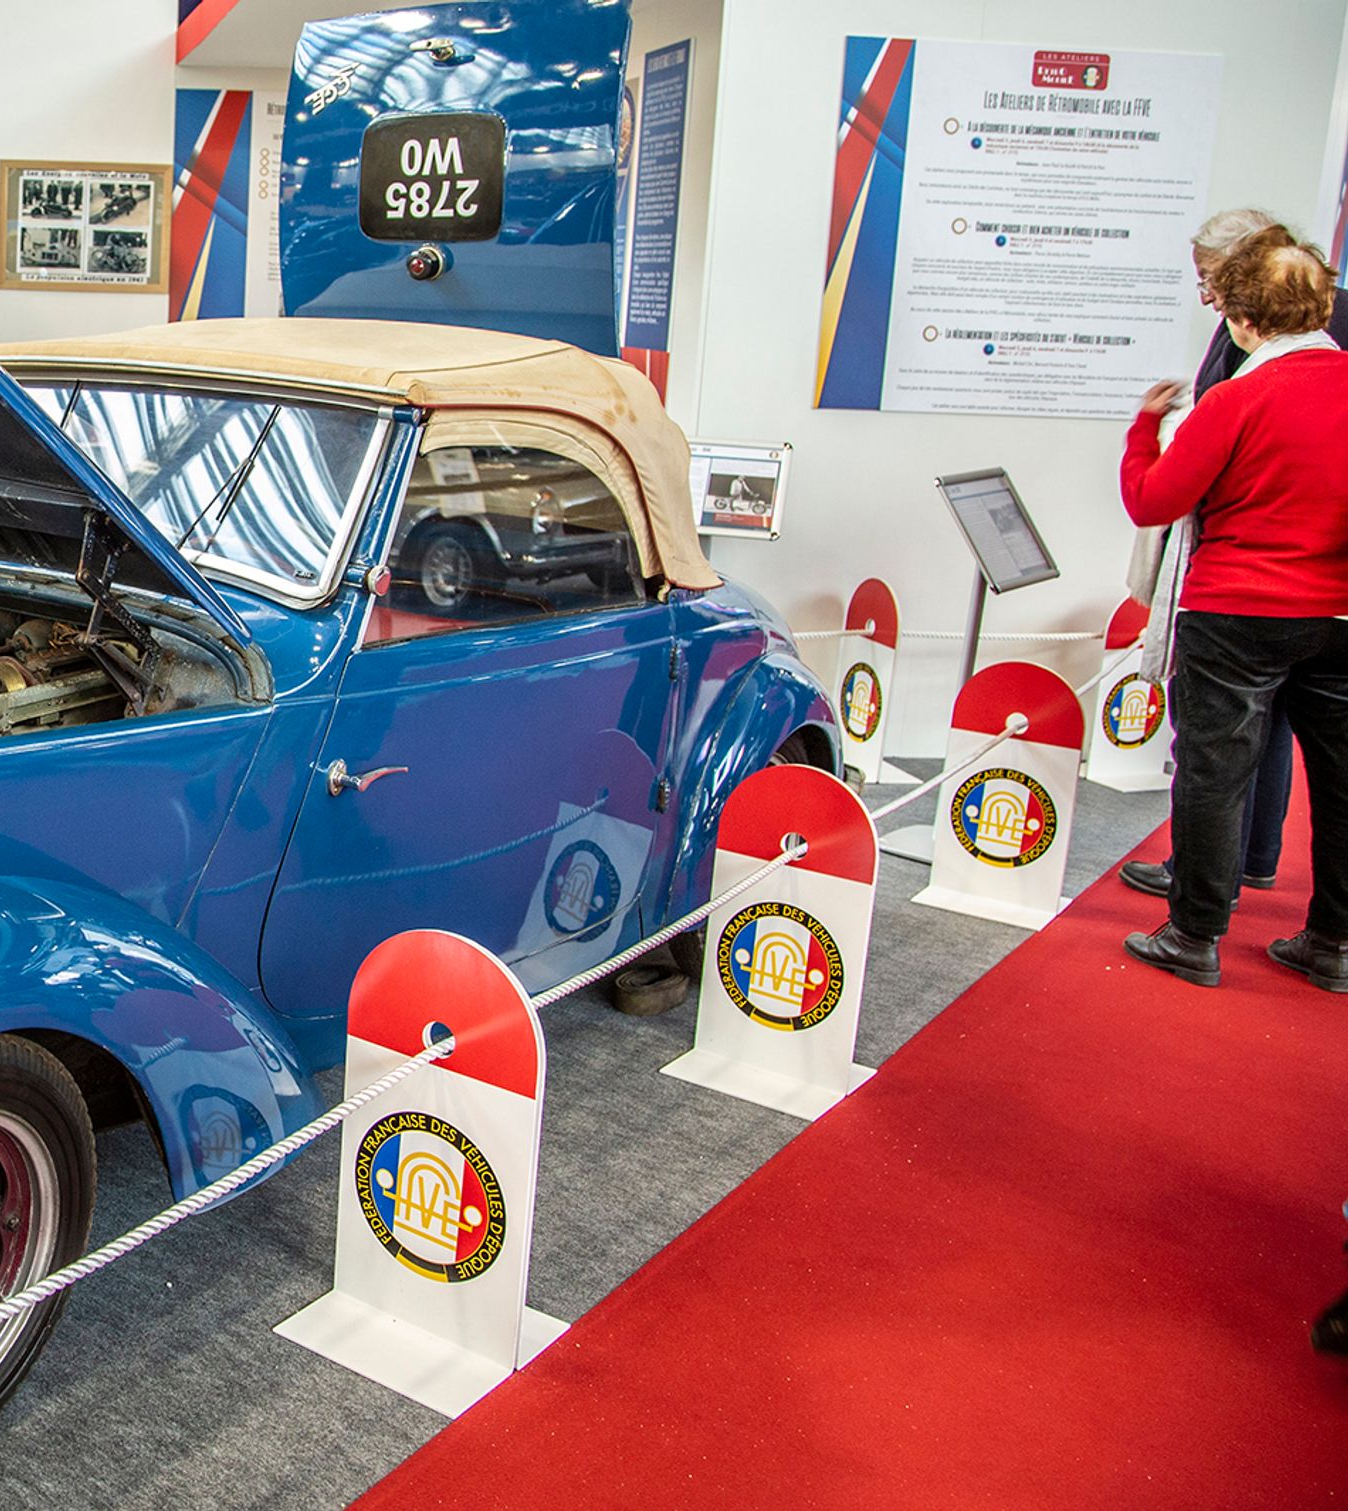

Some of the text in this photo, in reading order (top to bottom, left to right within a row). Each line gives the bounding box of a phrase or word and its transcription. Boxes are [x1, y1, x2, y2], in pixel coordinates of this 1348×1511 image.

[1061, 54, 1100, 62] ATELIERS
[385, 179, 480, 218] 2785
[725, 903, 779, 939] FRANÇAISE
[782, 905, 805, 921] DES
[356, 1113, 503, 1280] FÉDÉRATION FRANÇAISE DES VÉHICULES D'ÉPOQUE
